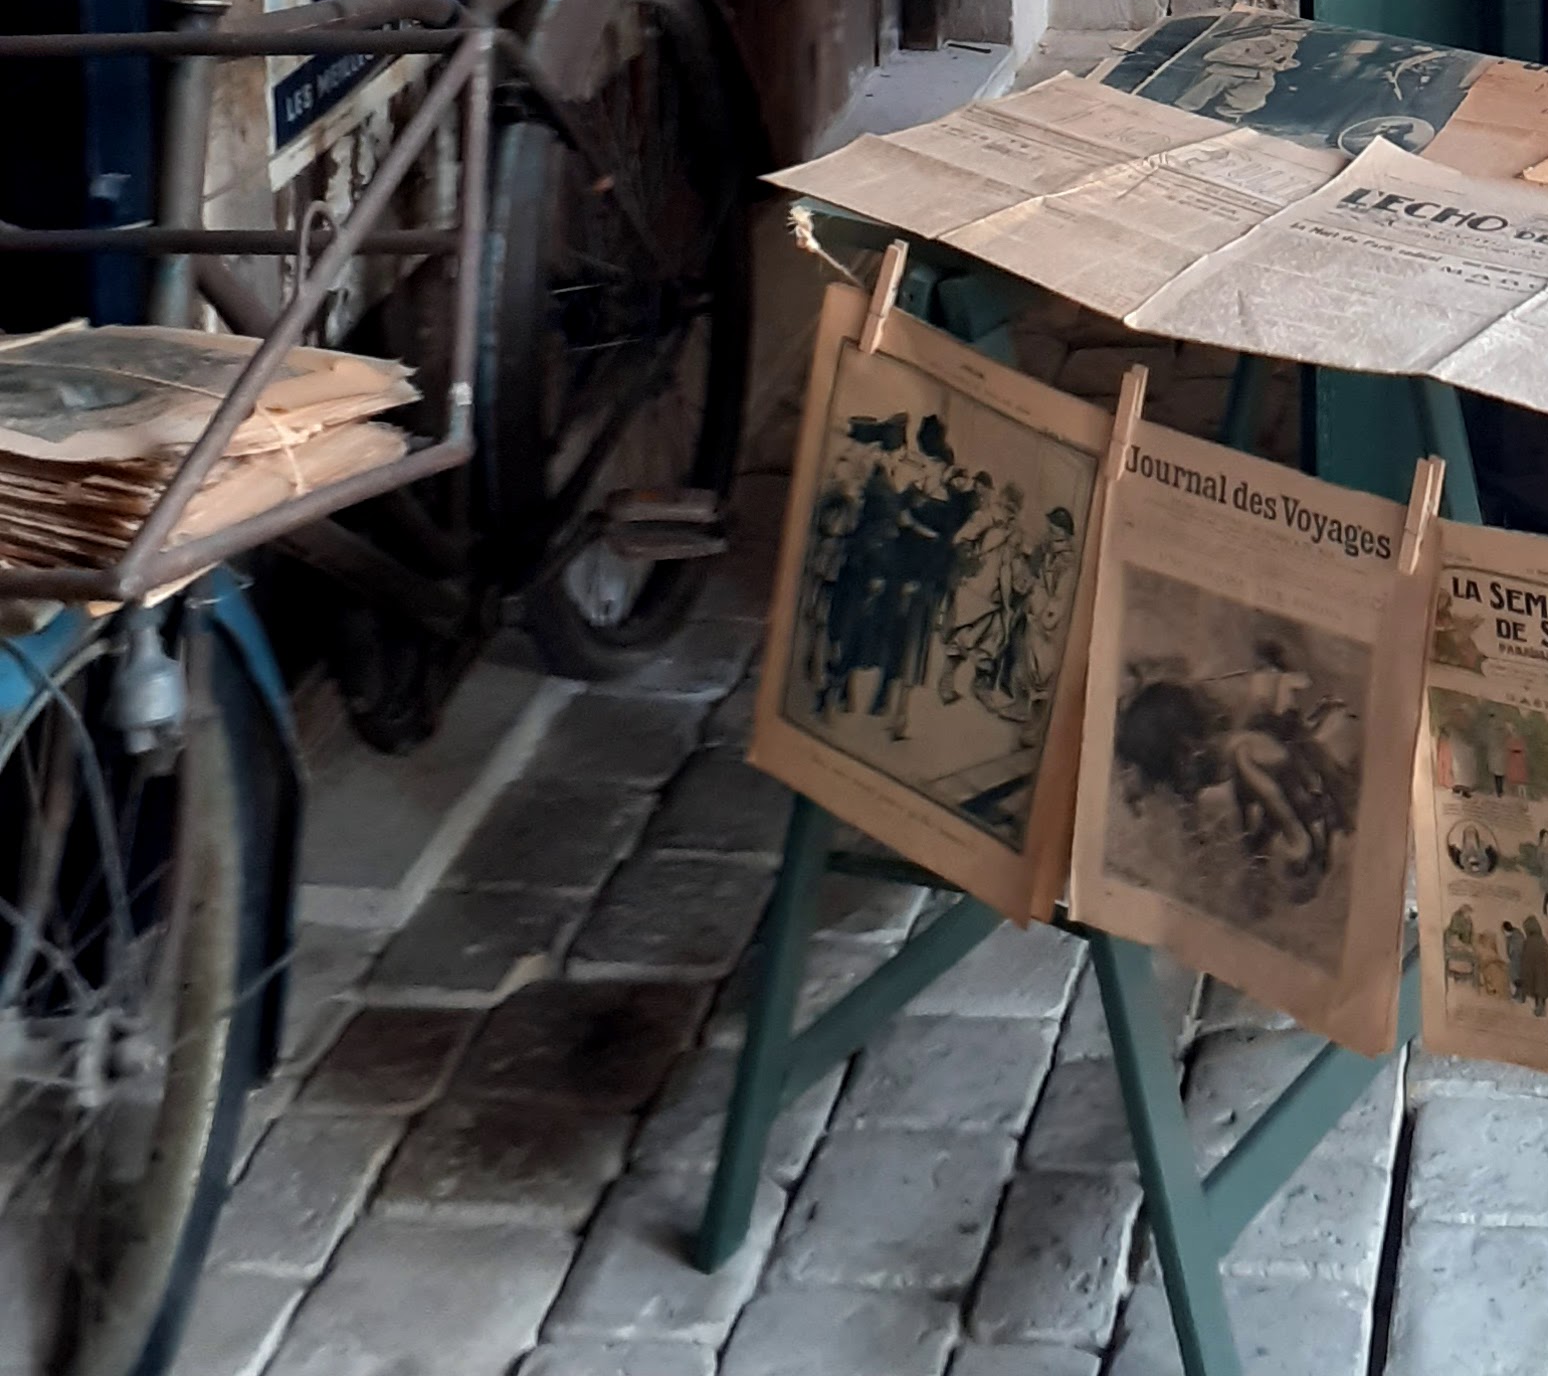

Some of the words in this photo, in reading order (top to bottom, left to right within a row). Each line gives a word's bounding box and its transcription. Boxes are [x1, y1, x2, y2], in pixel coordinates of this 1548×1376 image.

[1335, 186, 1509, 233] L'ECHO
[1124, 444, 1227, 506] Journal
[1232, 481, 1278, 522] des
[1280, 493, 1393, 560] Voyages
[1451, 575, 1482, 604] LA
[1495, 617, 1528, 643] DE
